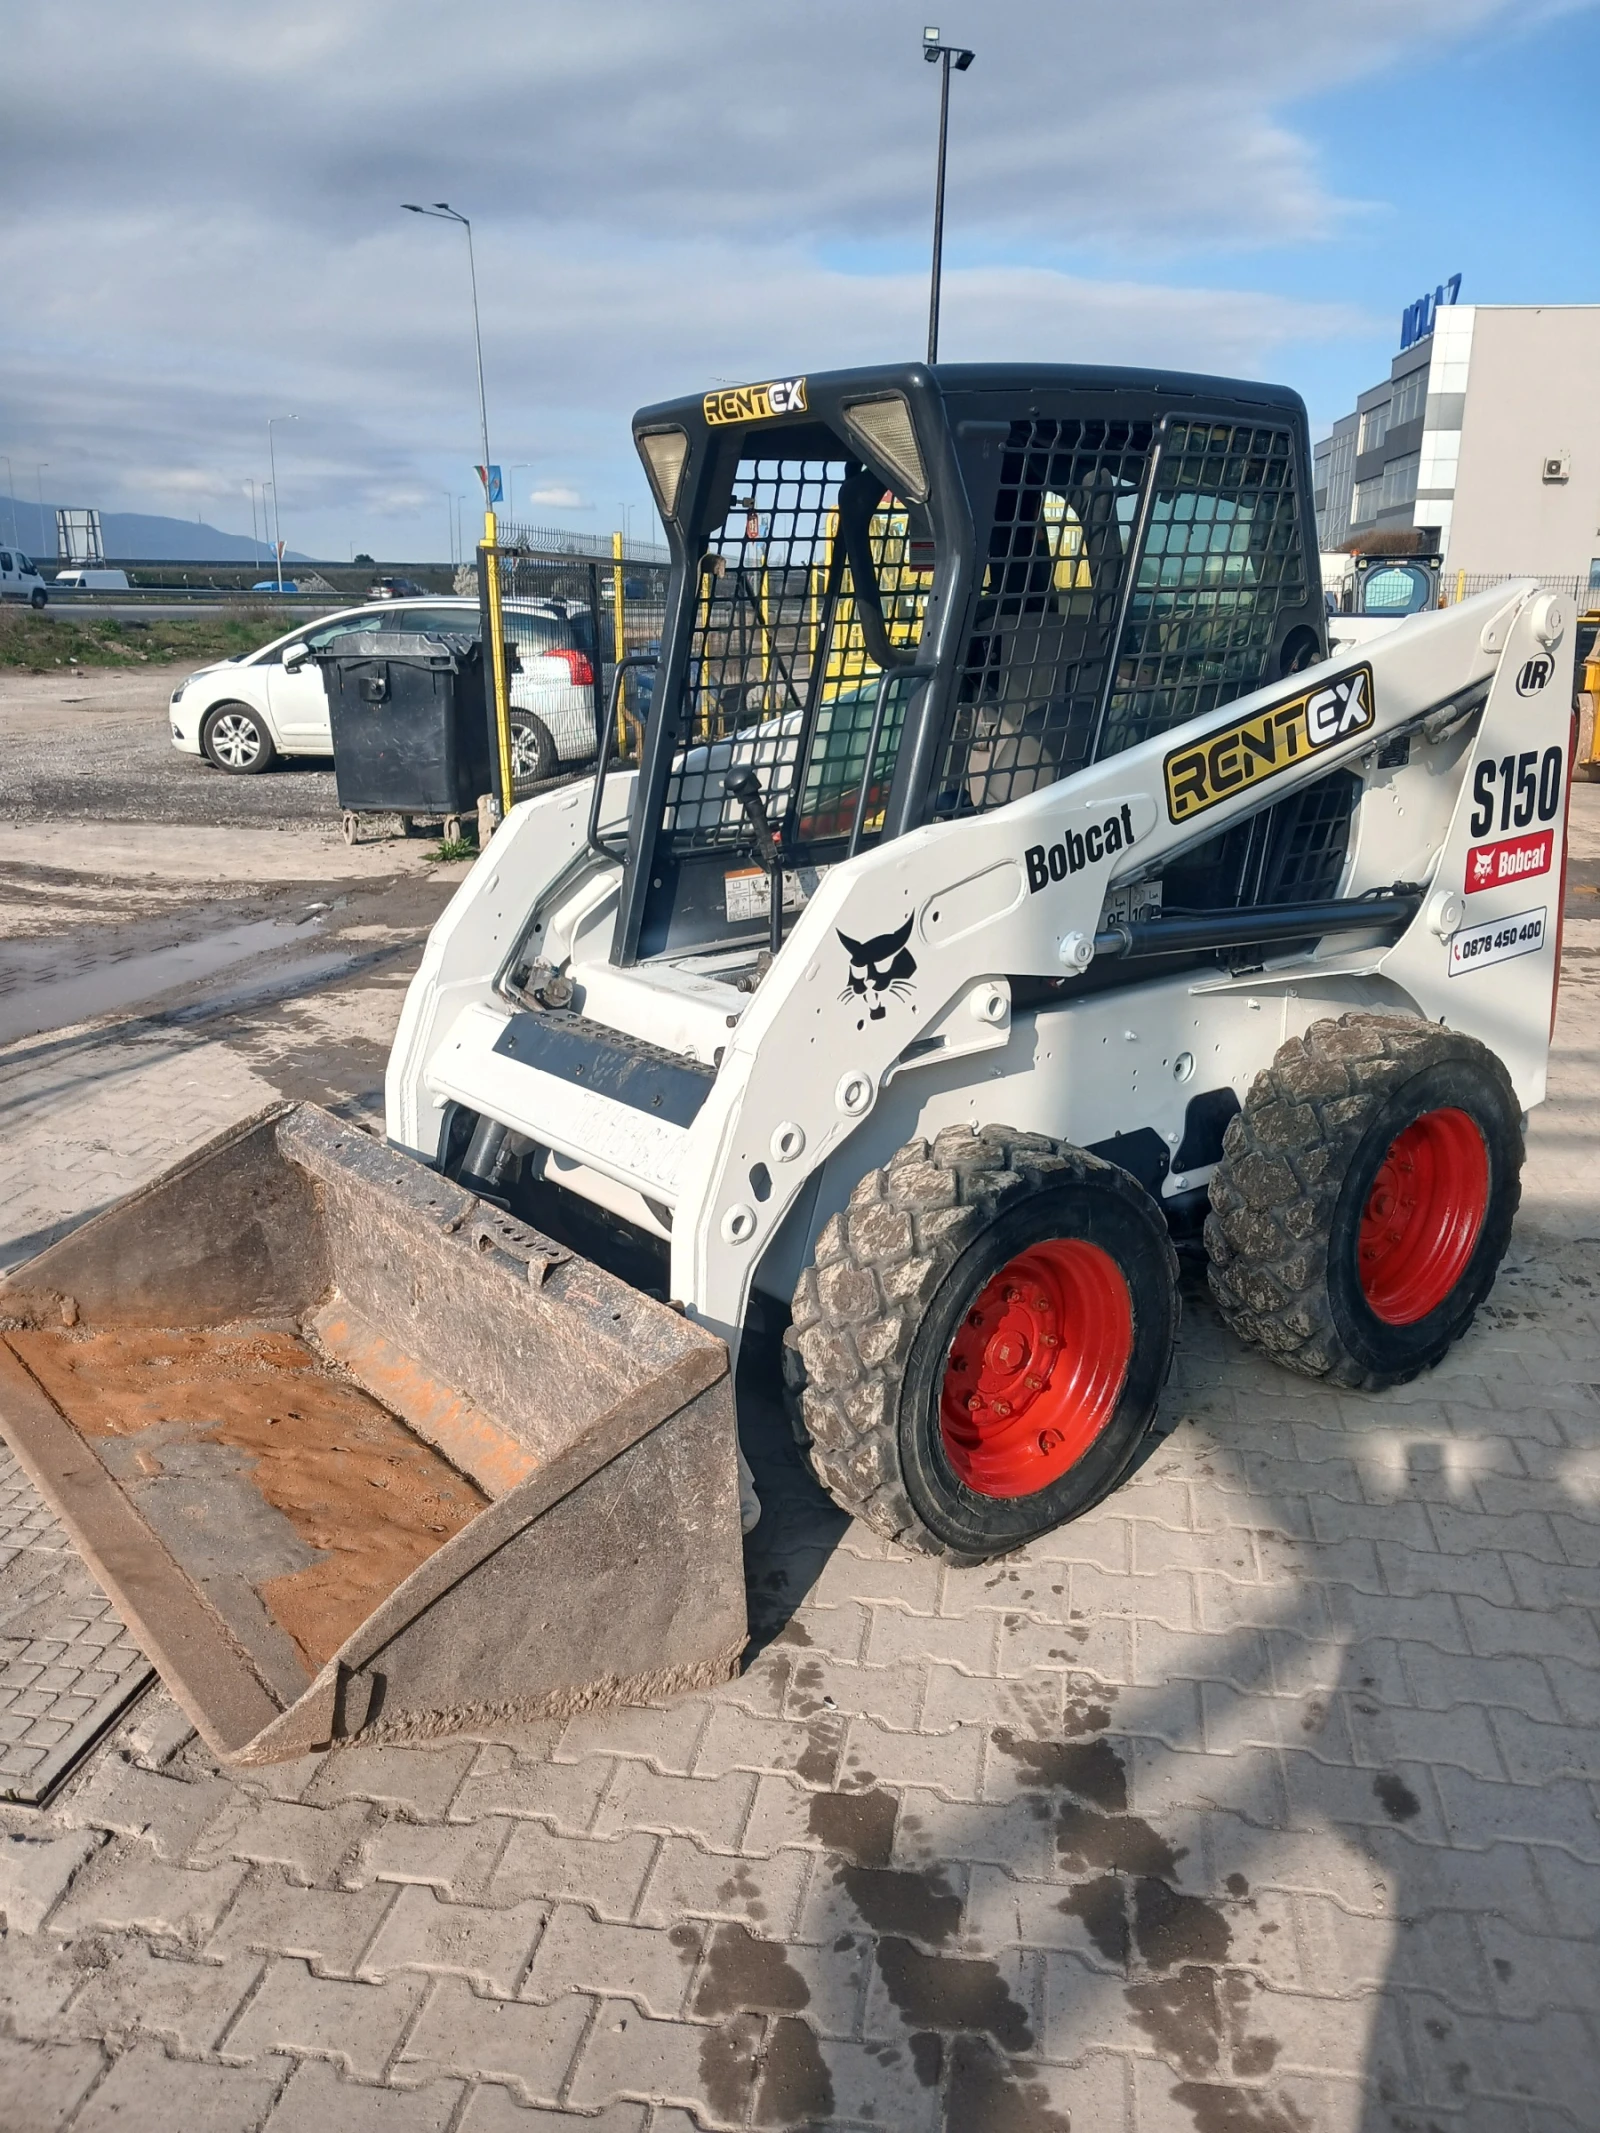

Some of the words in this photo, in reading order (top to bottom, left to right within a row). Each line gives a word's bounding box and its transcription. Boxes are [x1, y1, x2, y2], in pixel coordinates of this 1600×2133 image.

[705, 379, 805, 422] RENTEX
[1521, 660, 1549, 689] IR
[1171, 674, 1368, 814] RENTEX
[1470, 745, 1562, 838] S150
[1024, 803, 1135, 895] Bobcat
[1498, 843, 1546, 878] Bobcat
[1462, 935, 1493, 959] 0878
[1494, 927, 1518, 948] 450
[1519, 920, 1542, 941] 400
